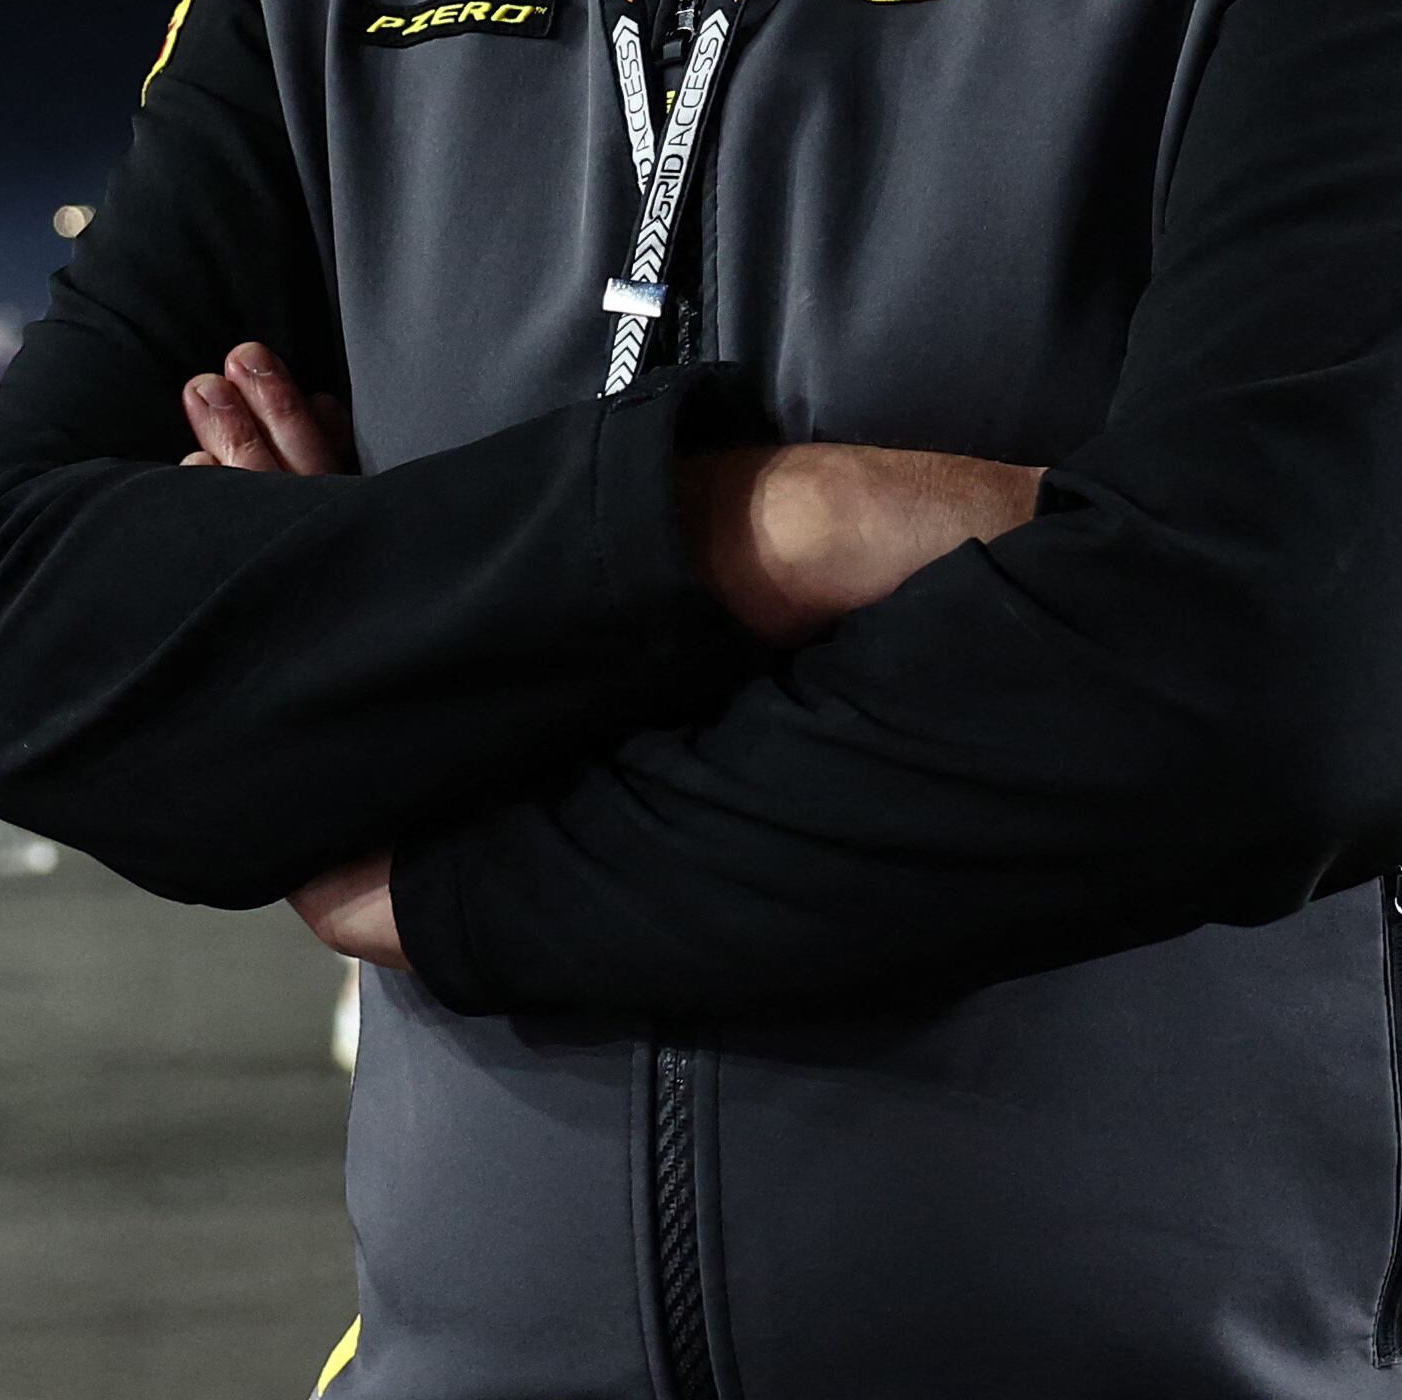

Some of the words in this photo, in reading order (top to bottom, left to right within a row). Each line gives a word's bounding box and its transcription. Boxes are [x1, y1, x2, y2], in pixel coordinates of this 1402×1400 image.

[618, 40, 650, 153] ACCESS
[649, 153, 685, 220] GRID
[668, 37, 719, 146] ACCESS
